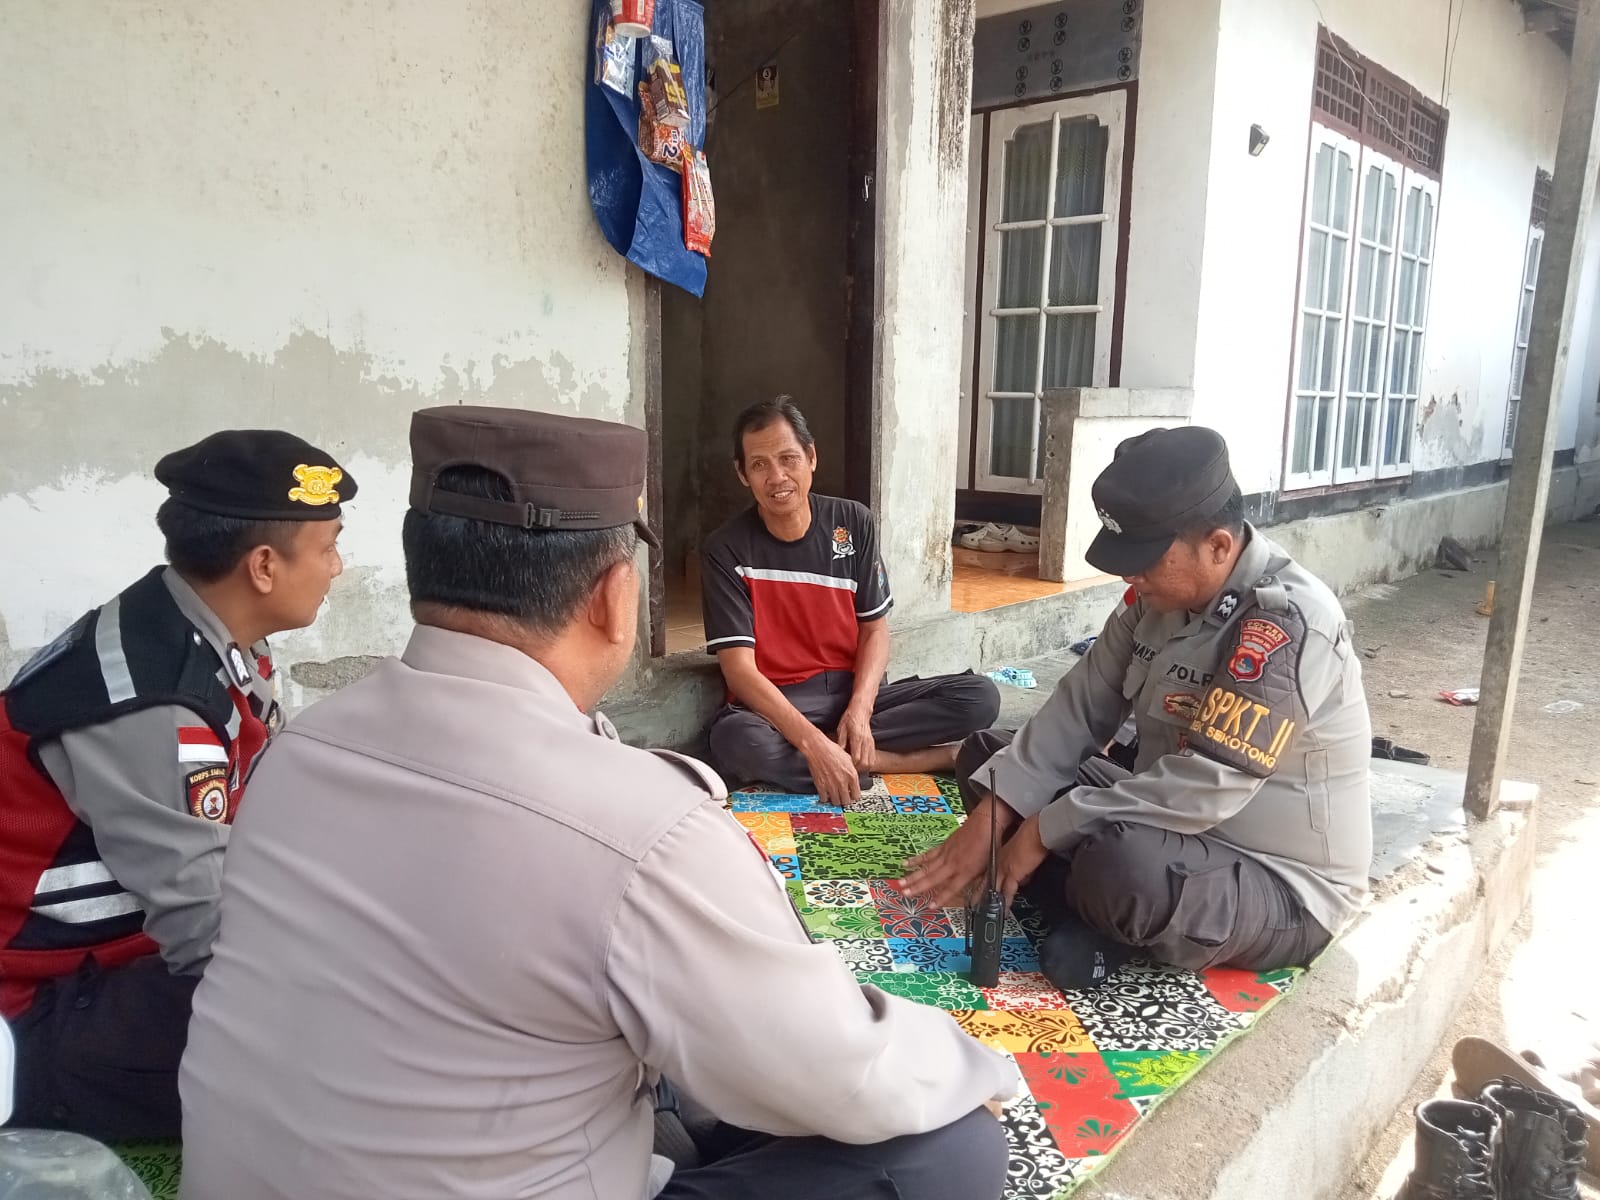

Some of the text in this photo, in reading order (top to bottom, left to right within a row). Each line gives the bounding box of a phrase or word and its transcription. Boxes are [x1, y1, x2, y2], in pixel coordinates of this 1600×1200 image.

[662, 144, 678, 158] 2
[1202, 688, 1270, 741] SPKT
[1206, 726, 1277, 768] SEKOTONG
